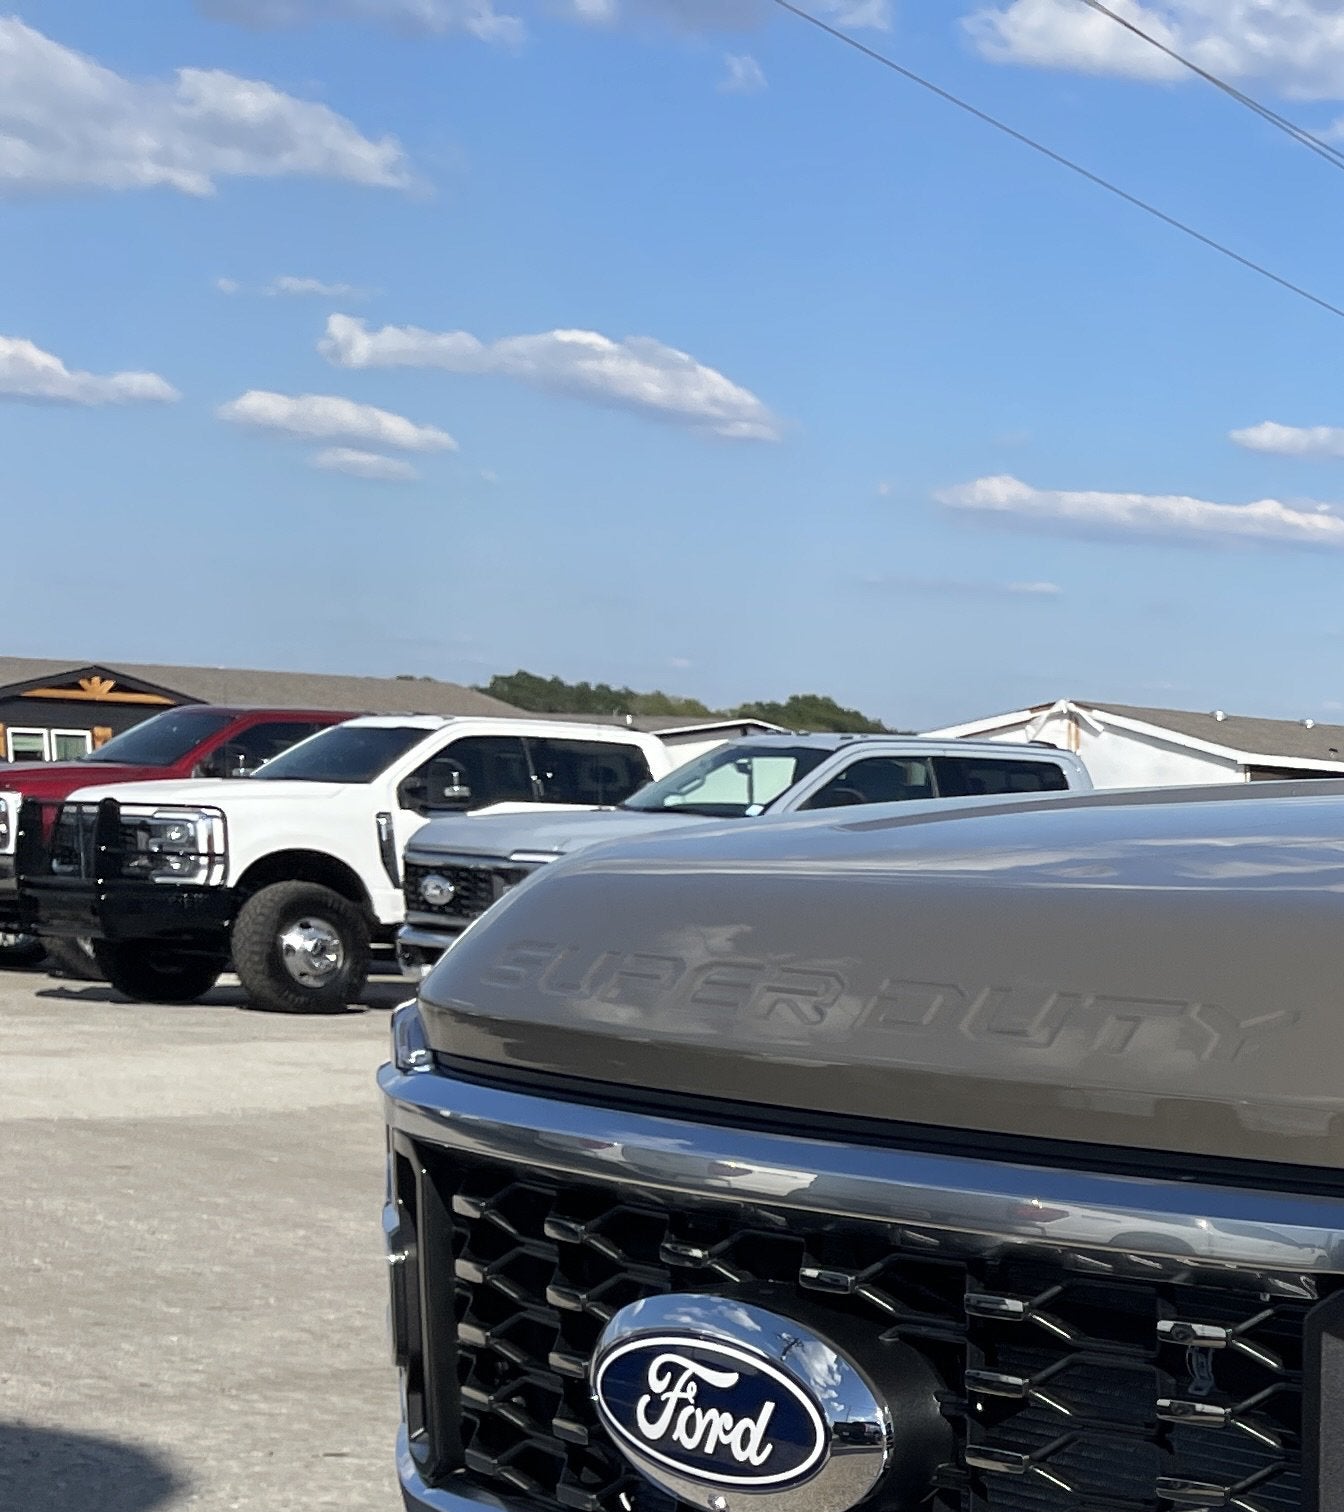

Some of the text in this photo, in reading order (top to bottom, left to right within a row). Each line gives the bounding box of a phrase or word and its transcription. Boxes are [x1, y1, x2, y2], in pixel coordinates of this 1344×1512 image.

[481, 939, 1302, 1064] SUPER DUTY
[636, 1353, 776, 1466] Ford
